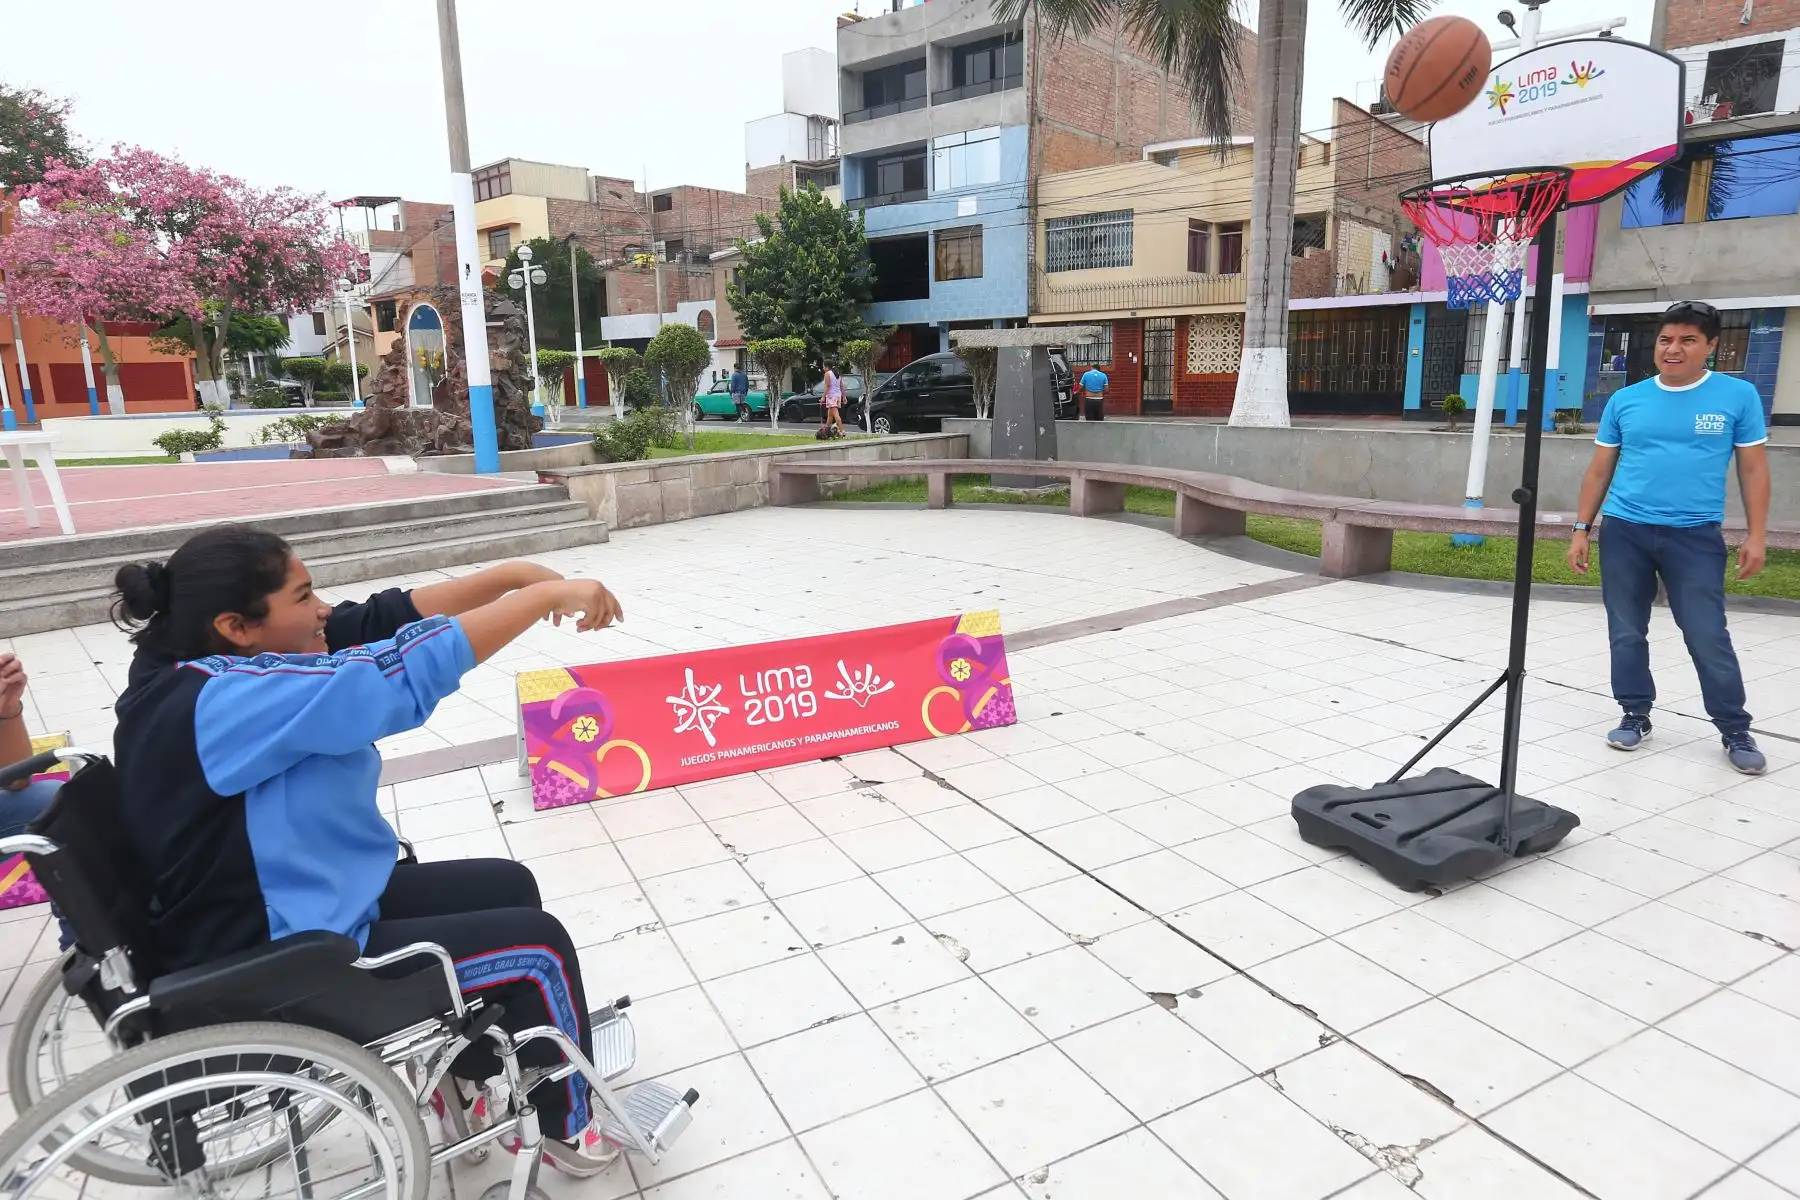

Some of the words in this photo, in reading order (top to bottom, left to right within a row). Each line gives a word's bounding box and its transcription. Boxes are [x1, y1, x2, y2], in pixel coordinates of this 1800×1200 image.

[1518, 81, 1557, 104] 2019
[1694, 421, 1724, 430] 2019
[744, 690, 817, 726] 2019
[680, 752, 716, 767] JUEGOS
[717, 737, 796, 760] PANAMERICANOS
[797, 736, 803, 746] Y
[804, 720, 900, 744] PARAPANAMERICANOS
[464, 963, 492, 978] MIGUEL
[495, 958, 516, 970] GRAU
